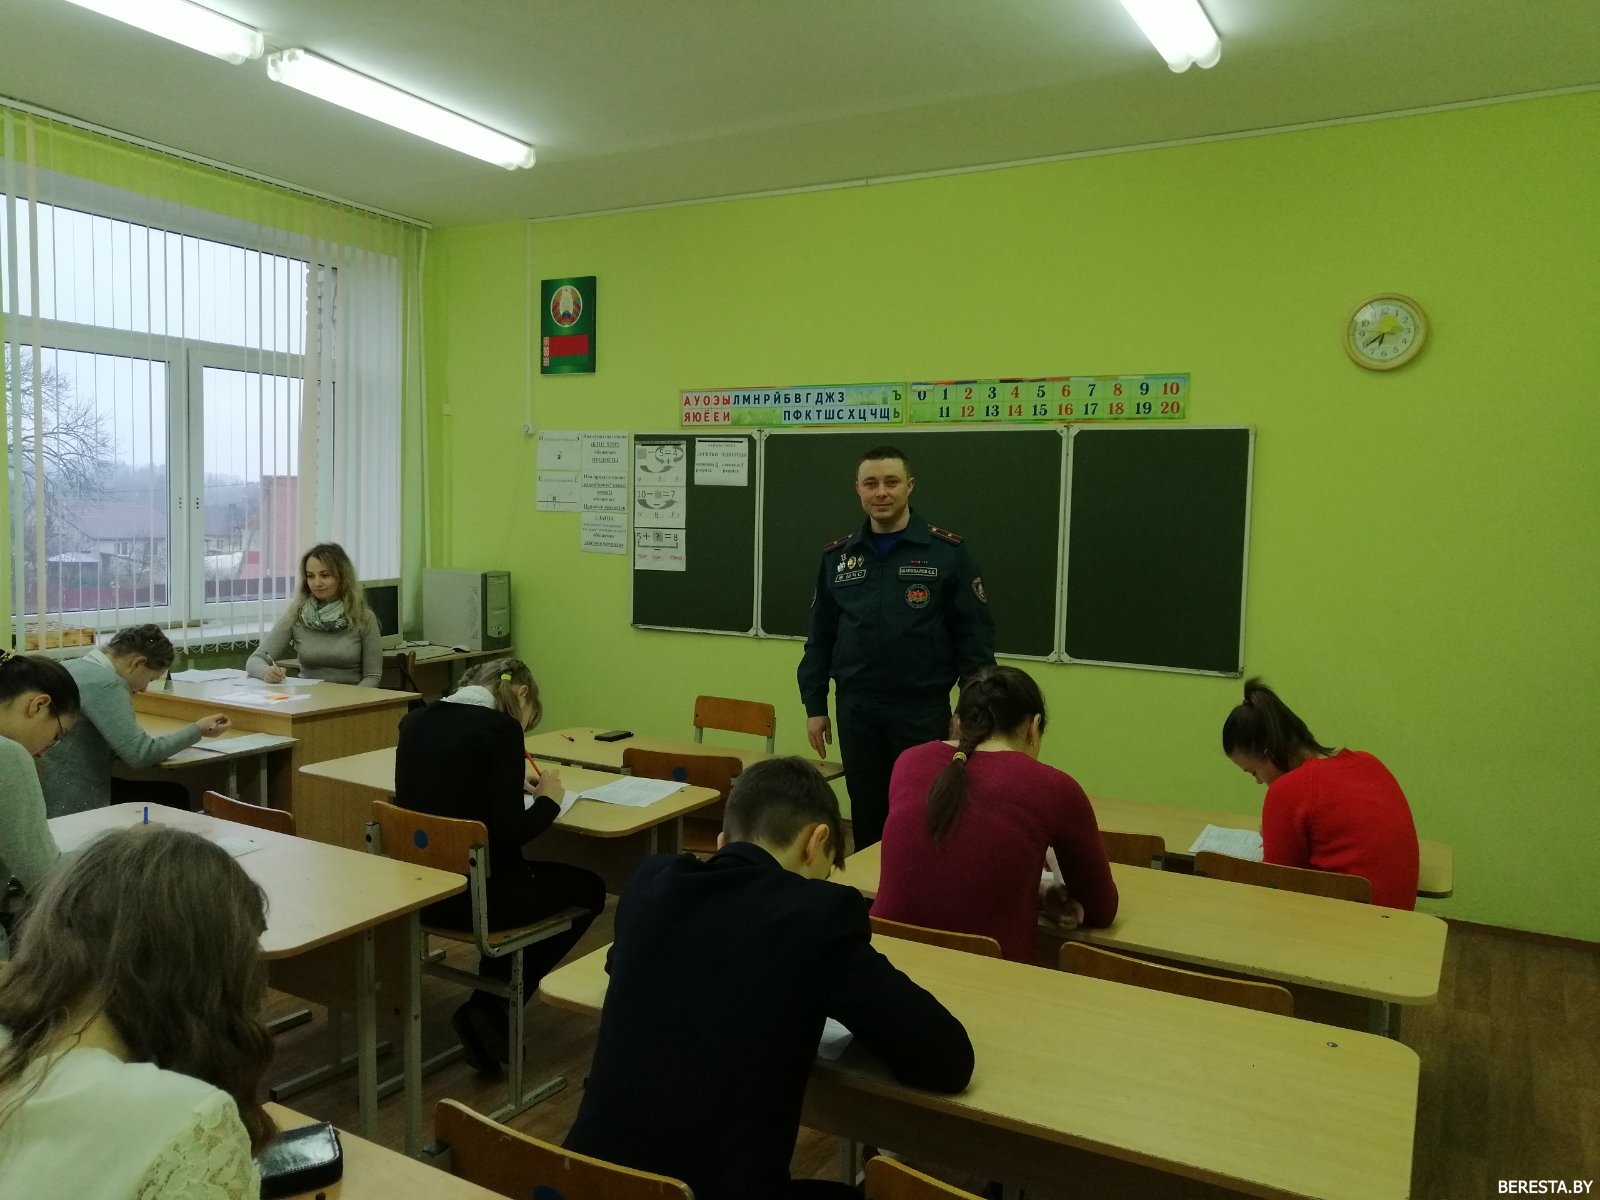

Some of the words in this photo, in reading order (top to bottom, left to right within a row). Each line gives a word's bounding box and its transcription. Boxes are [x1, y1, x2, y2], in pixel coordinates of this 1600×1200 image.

[917, 390, 927, 401] 0
[942, 387, 948, 400] 1
[964, 387, 973, 400] 2
[987, 386, 997, 399] 3
[1010, 385, 1019, 398] 4
[1036, 385, 1046, 398] 5
[1061, 384, 1071, 397] 6
[1088, 383, 1097, 397] 7
[1113, 382, 1123, 396] 8
[1139, 382, 1150, 396] 9
[1162, 381, 1180, 395] 10
[938, 405, 951, 418] 11
[961, 405, 975, 418] 12
[985, 404, 1000, 417] 13
[1008, 404, 1023, 416] 14
[1032, 403, 1048, 416] 15
[1057, 403, 1074, 416] 16
[1083, 402, 1099, 415] 17
[1109, 402, 1124, 415] 18
[1135, 401, 1152, 415] 19
[1160, 401, 1181, 414] 20
